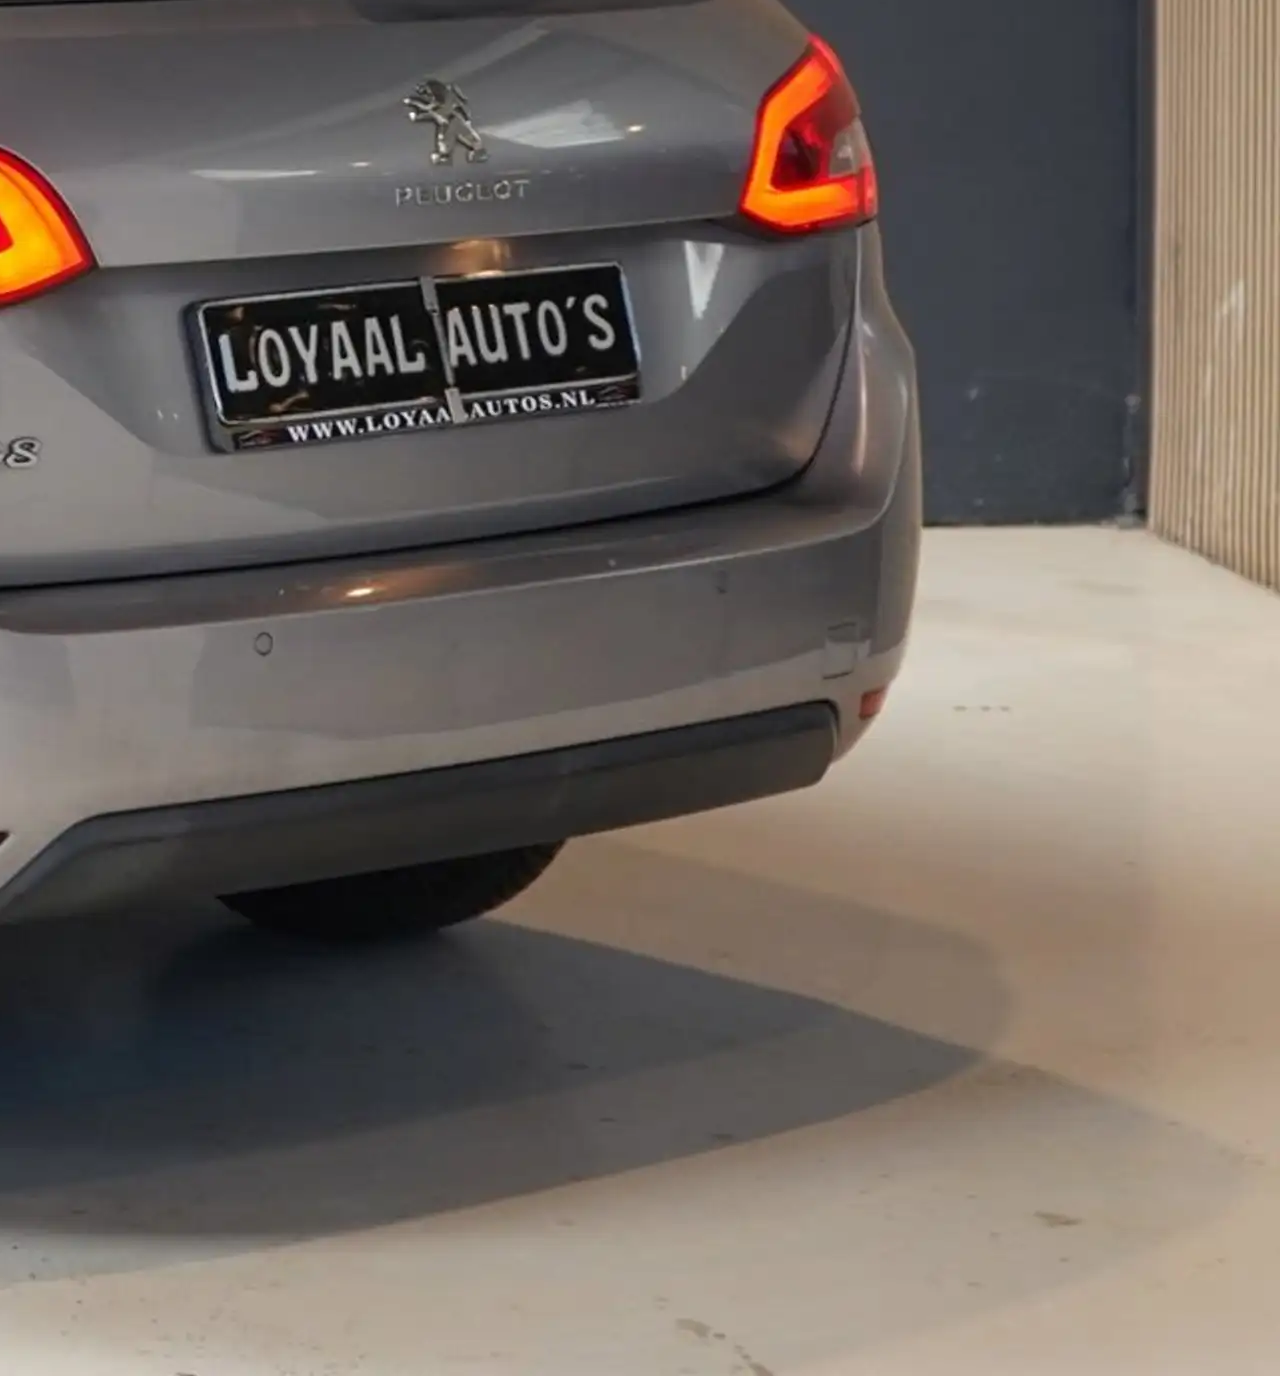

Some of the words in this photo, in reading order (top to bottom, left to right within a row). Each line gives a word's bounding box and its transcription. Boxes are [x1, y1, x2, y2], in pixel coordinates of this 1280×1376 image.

[218, 314, 426, 393] LOYAAL
[447, 294, 615, 368] AUTO'S
[288, 390, 595, 443] WWW.LOYAAAUTOS.NL
